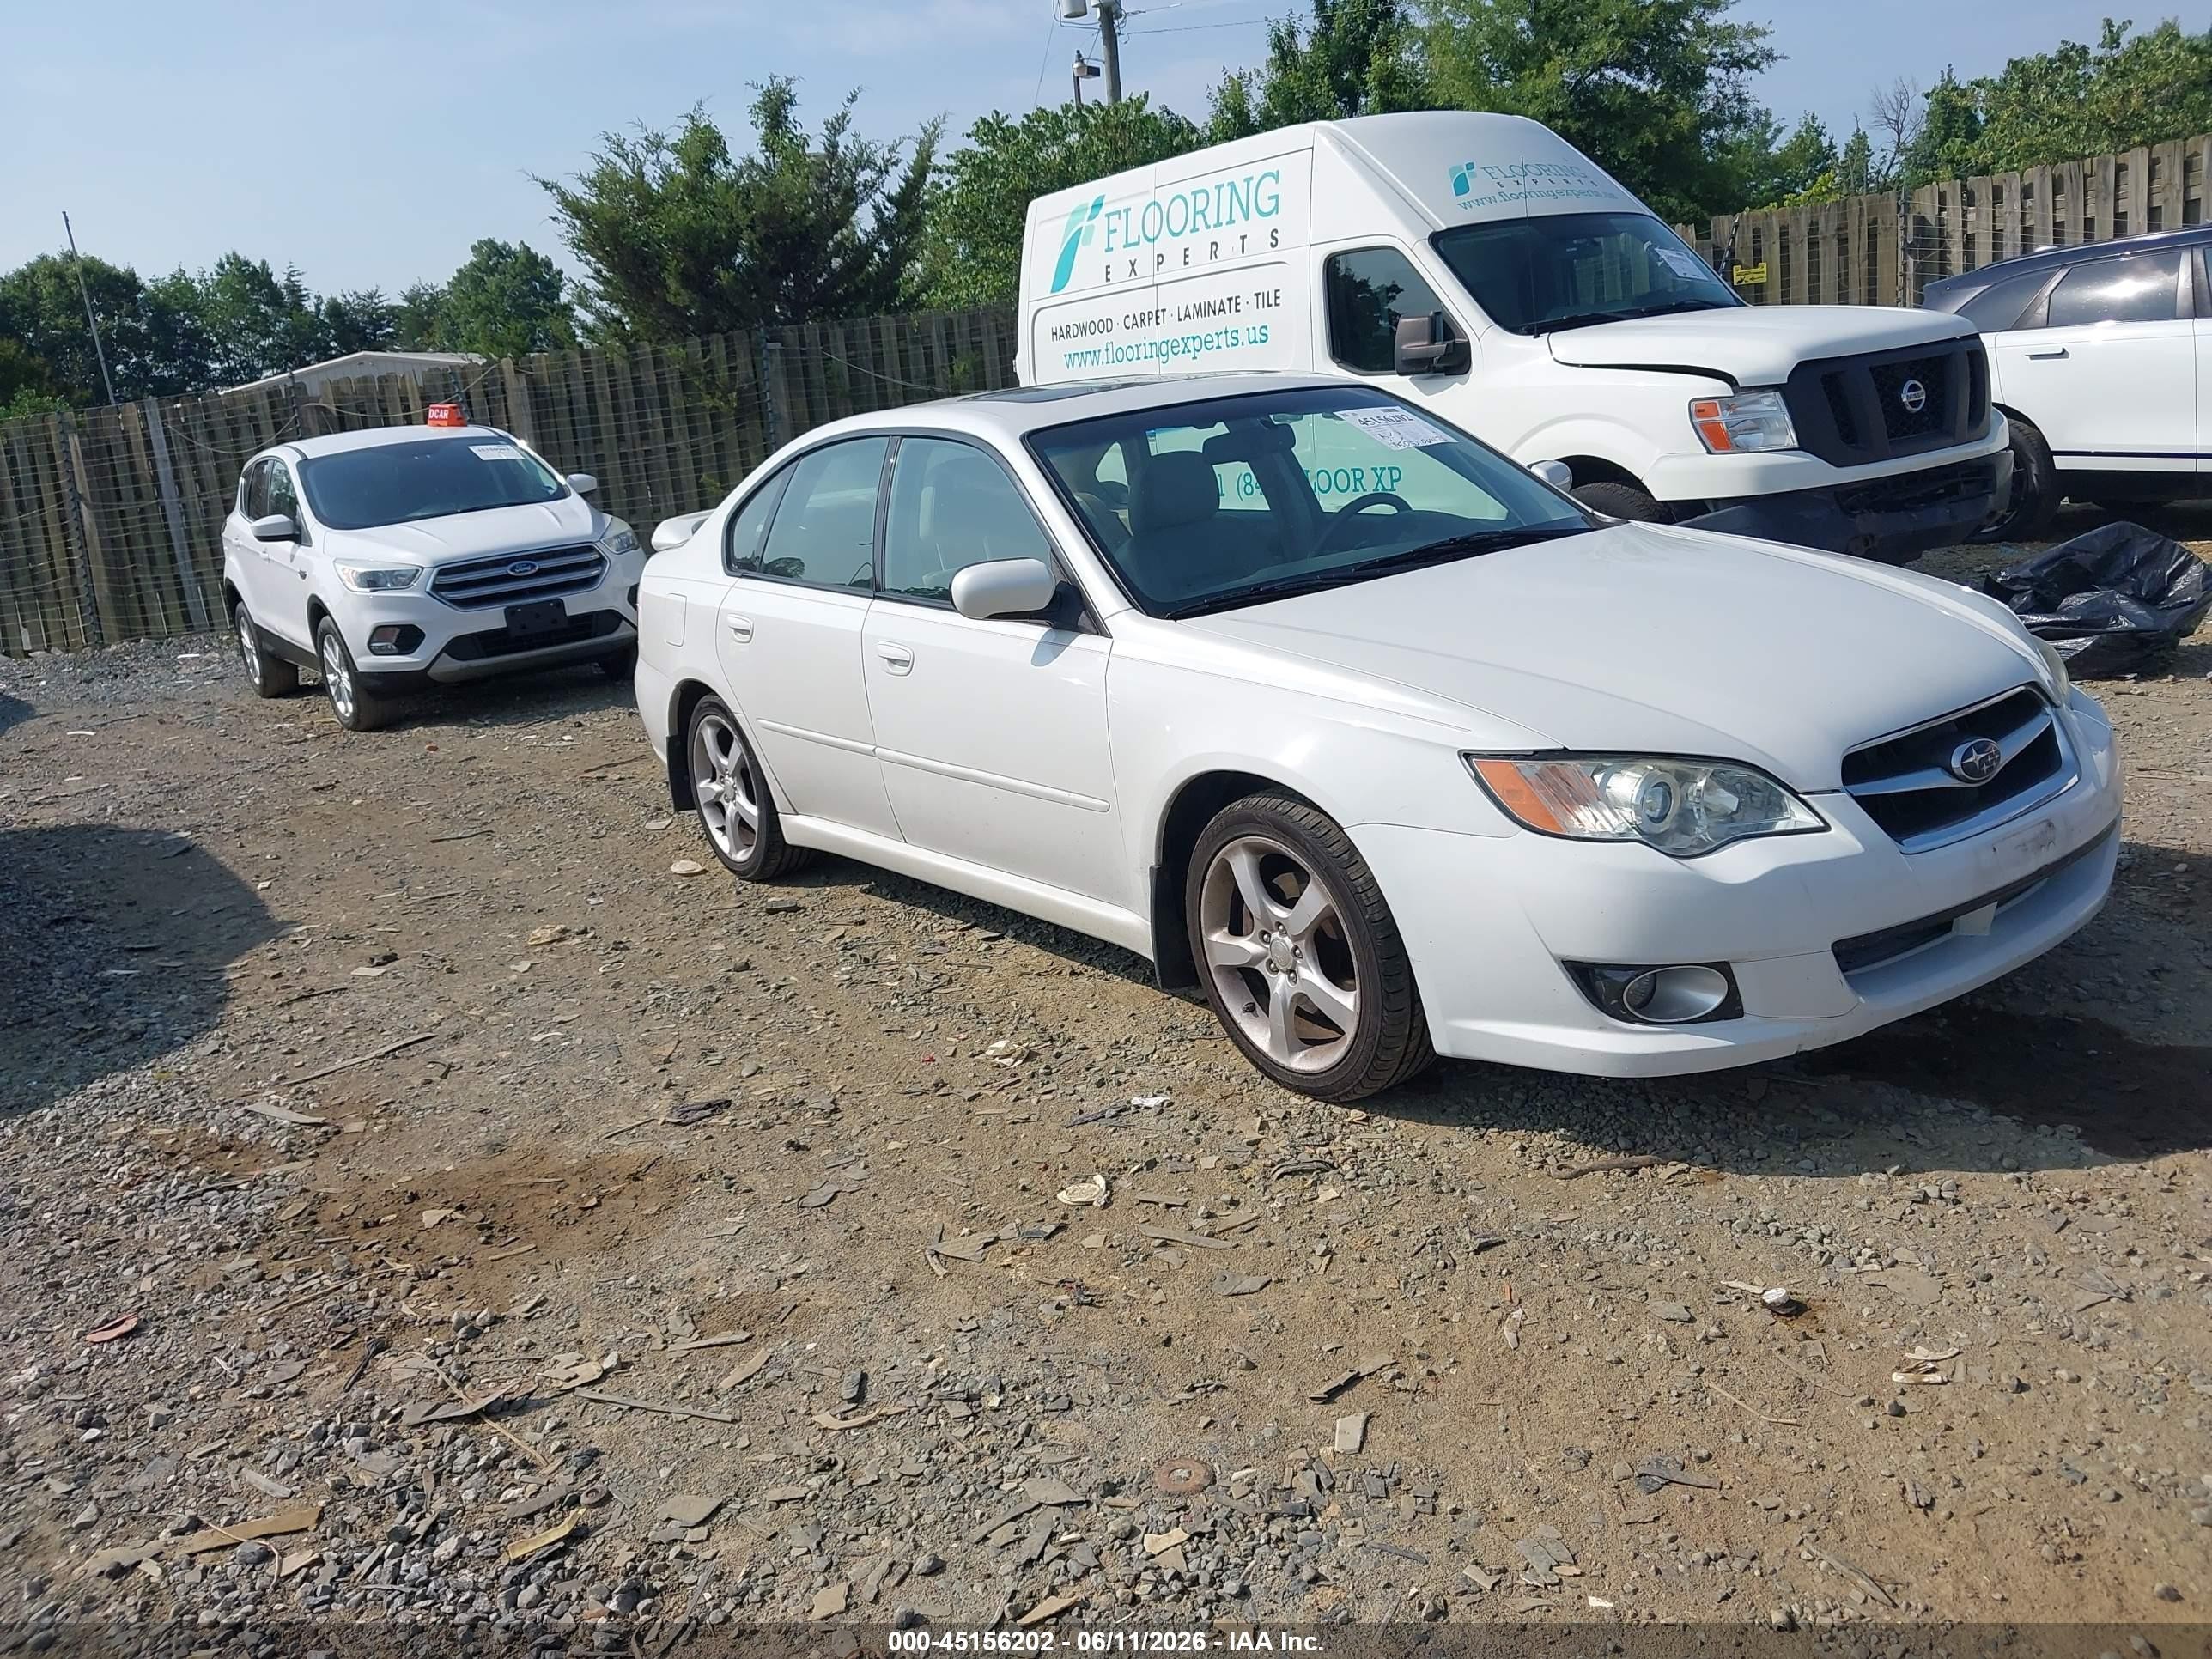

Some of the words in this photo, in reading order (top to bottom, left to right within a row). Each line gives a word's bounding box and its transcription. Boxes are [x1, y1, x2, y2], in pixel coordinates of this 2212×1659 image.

[1481, 163, 1588, 179] FLOORING
[1103, 169, 1280, 252] FLOORING
[1104, 228, 1279, 283] EXPERTS
[1050, 317, 1114, 343] HARDWOOD
[1122, 308, 1167, 331] CARPET
[1176, 295, 1242, 323] LAMINATE
[1253, 289, 1281, 310] TILE
[1063, 324, 1270, 370] www.flooringexperts.us
[1370, 466, 1402, 492] XP
